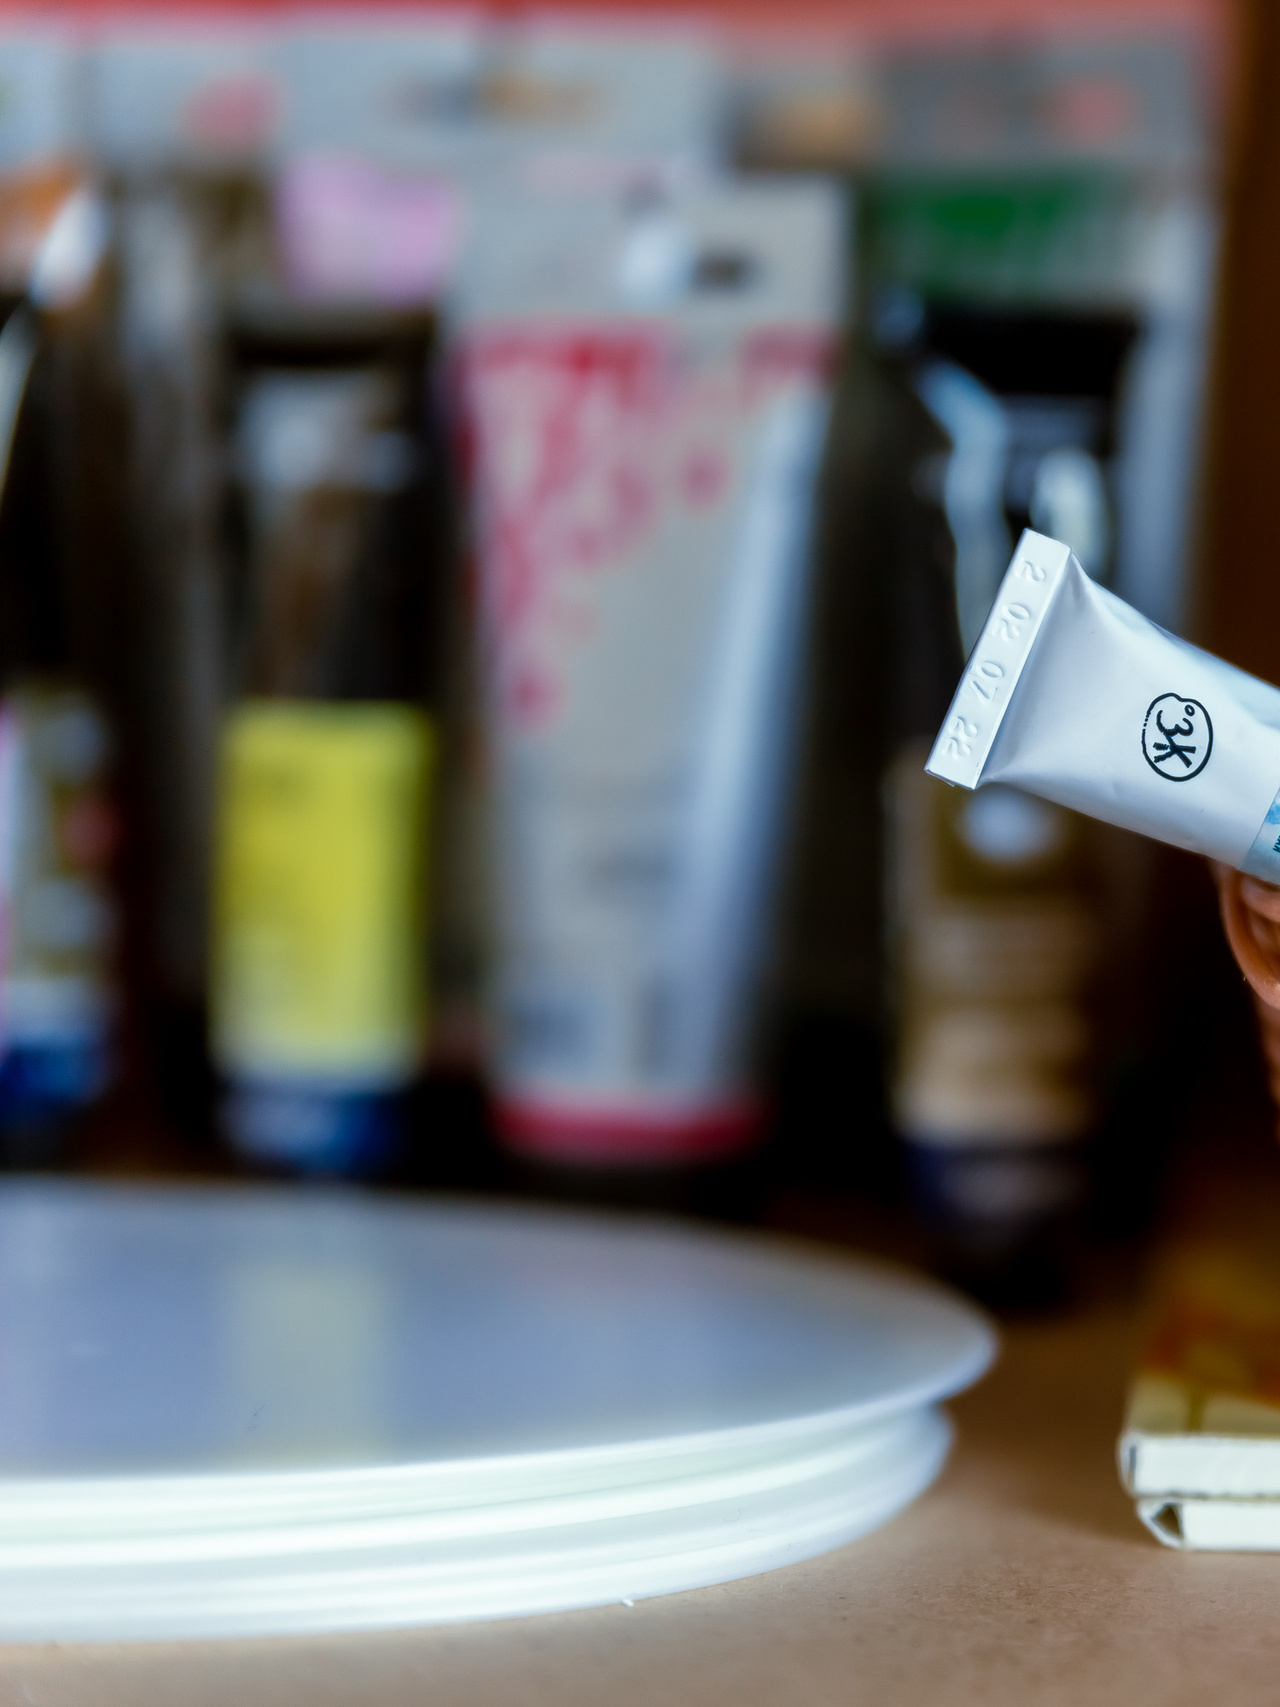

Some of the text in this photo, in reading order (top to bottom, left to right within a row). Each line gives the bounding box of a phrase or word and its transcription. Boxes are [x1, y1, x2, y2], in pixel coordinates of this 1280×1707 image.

[941, 560, 1046, 761] 2 02 07 22
